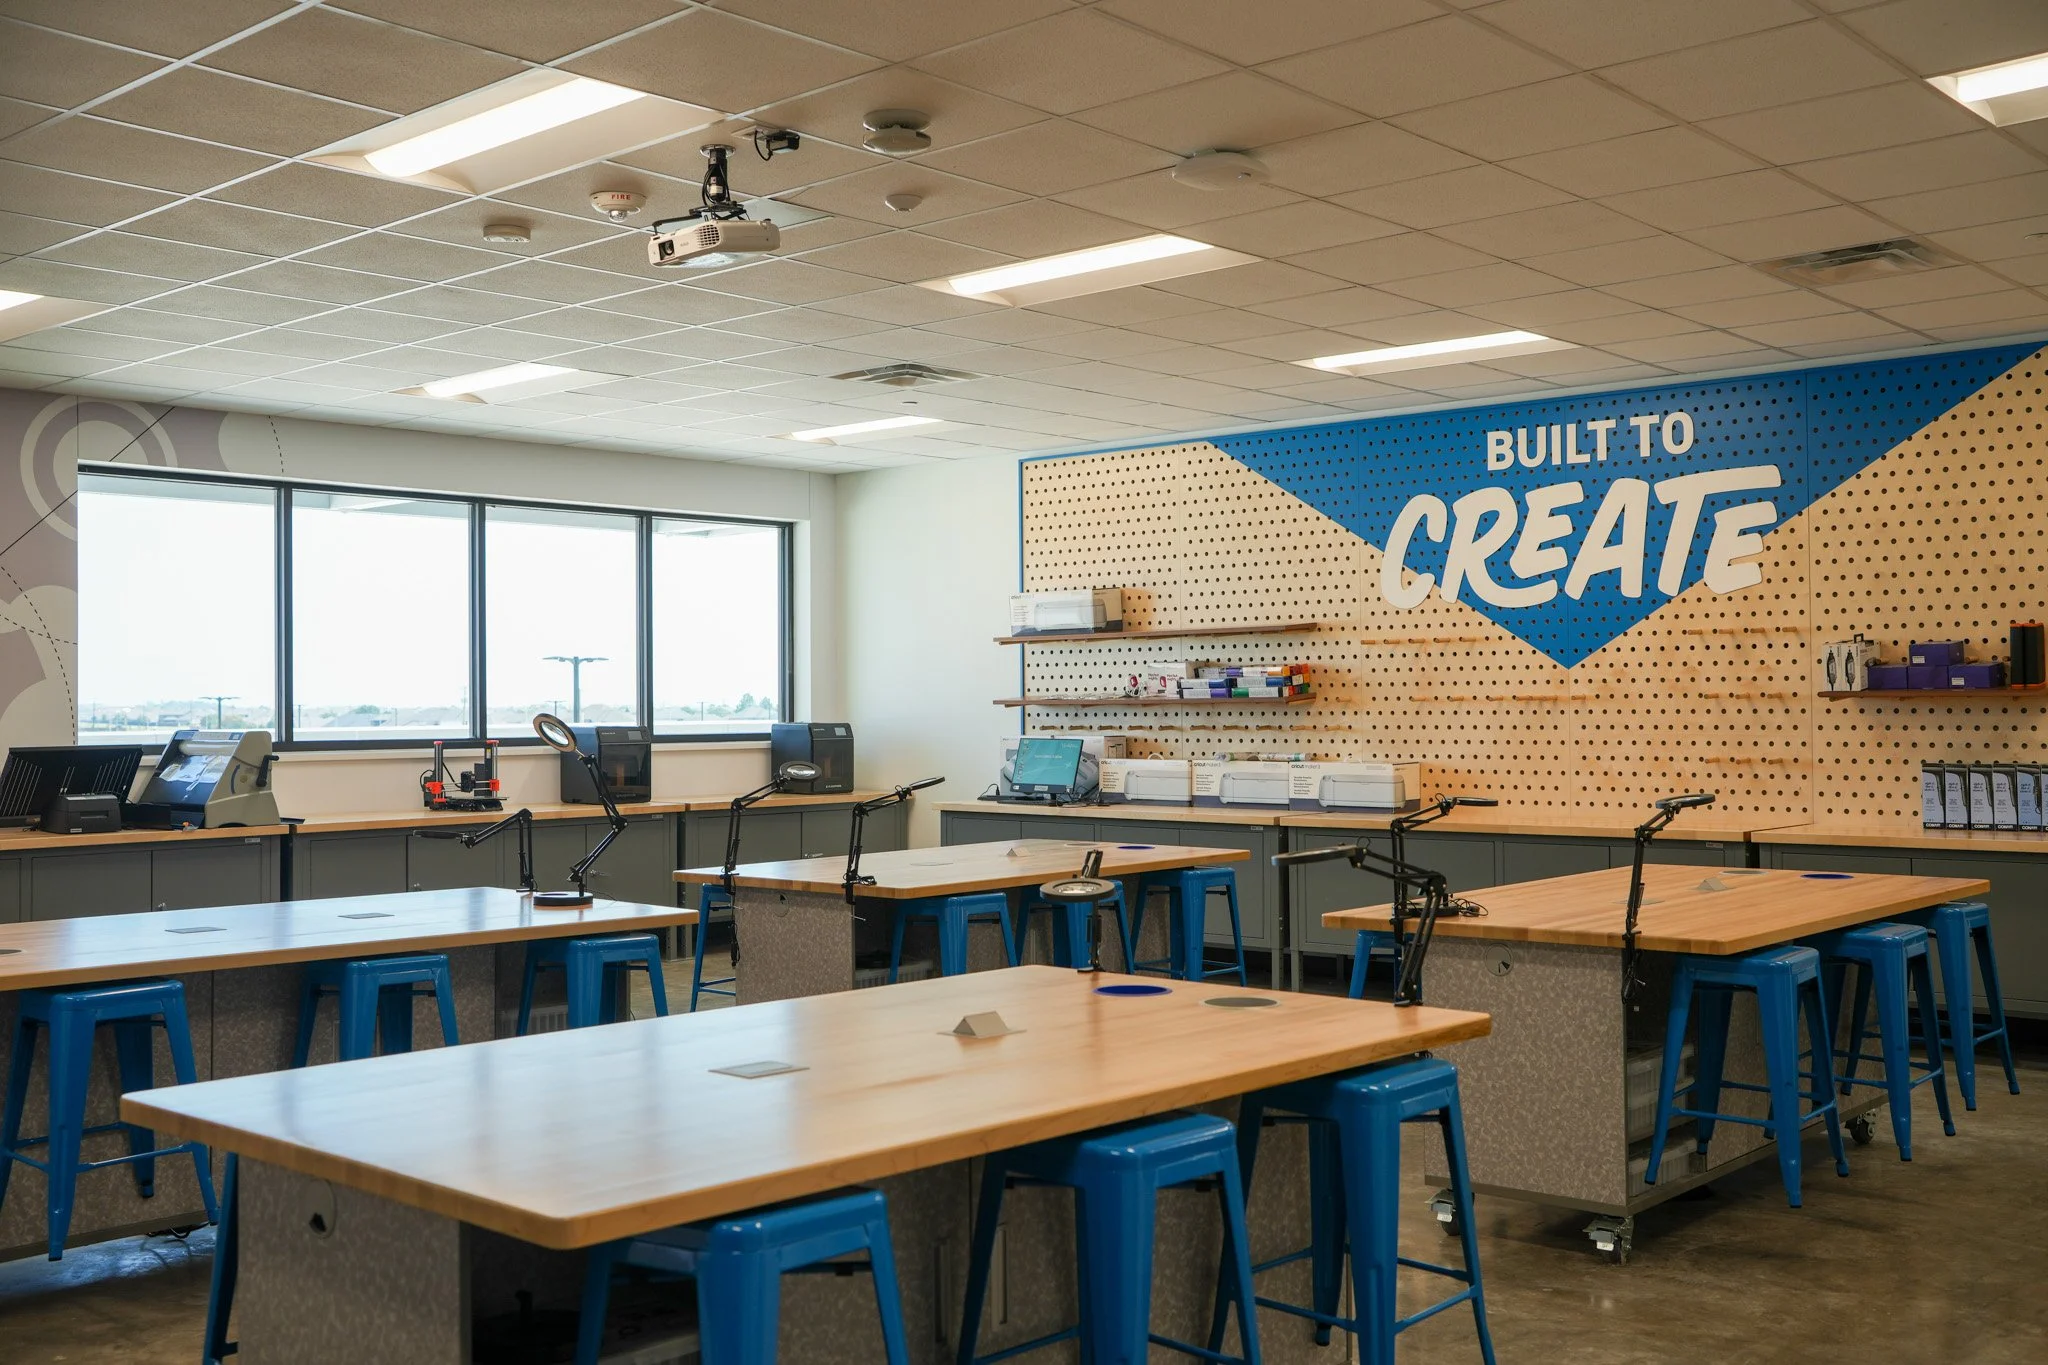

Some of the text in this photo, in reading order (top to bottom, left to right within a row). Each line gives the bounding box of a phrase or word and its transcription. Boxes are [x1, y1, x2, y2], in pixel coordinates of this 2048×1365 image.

[1487, 411, 1695, 471] BUILT TO
[1380, 464, 1782, 610] CREATE
